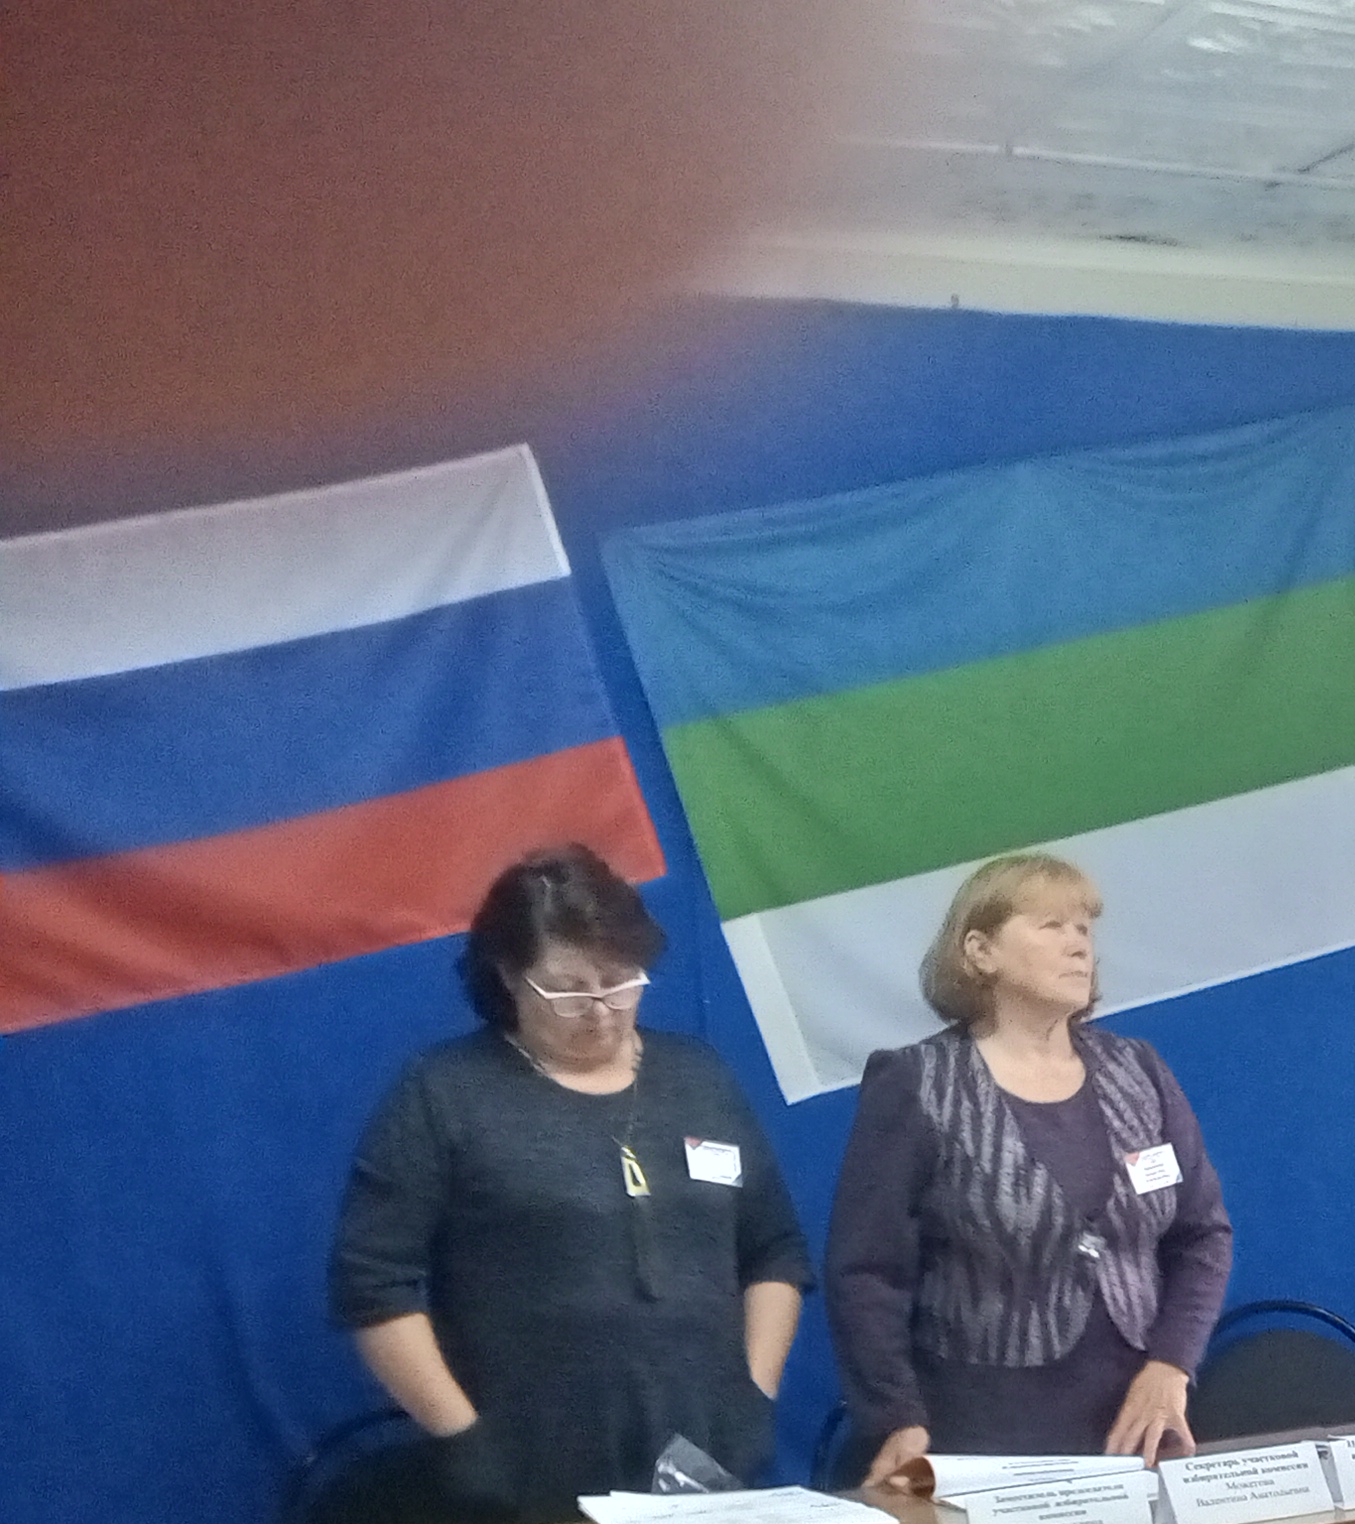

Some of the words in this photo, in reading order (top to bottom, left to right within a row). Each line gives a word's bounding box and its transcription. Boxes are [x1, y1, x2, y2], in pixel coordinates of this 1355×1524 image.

[1185, 1457, 1240, 1472] Секретарь
[1242, 1451, 1299, 1467] участковой
[1182, 1467, 1258, 1484] избирательной
[1261, 1462, 1309, 1476] комиссии
